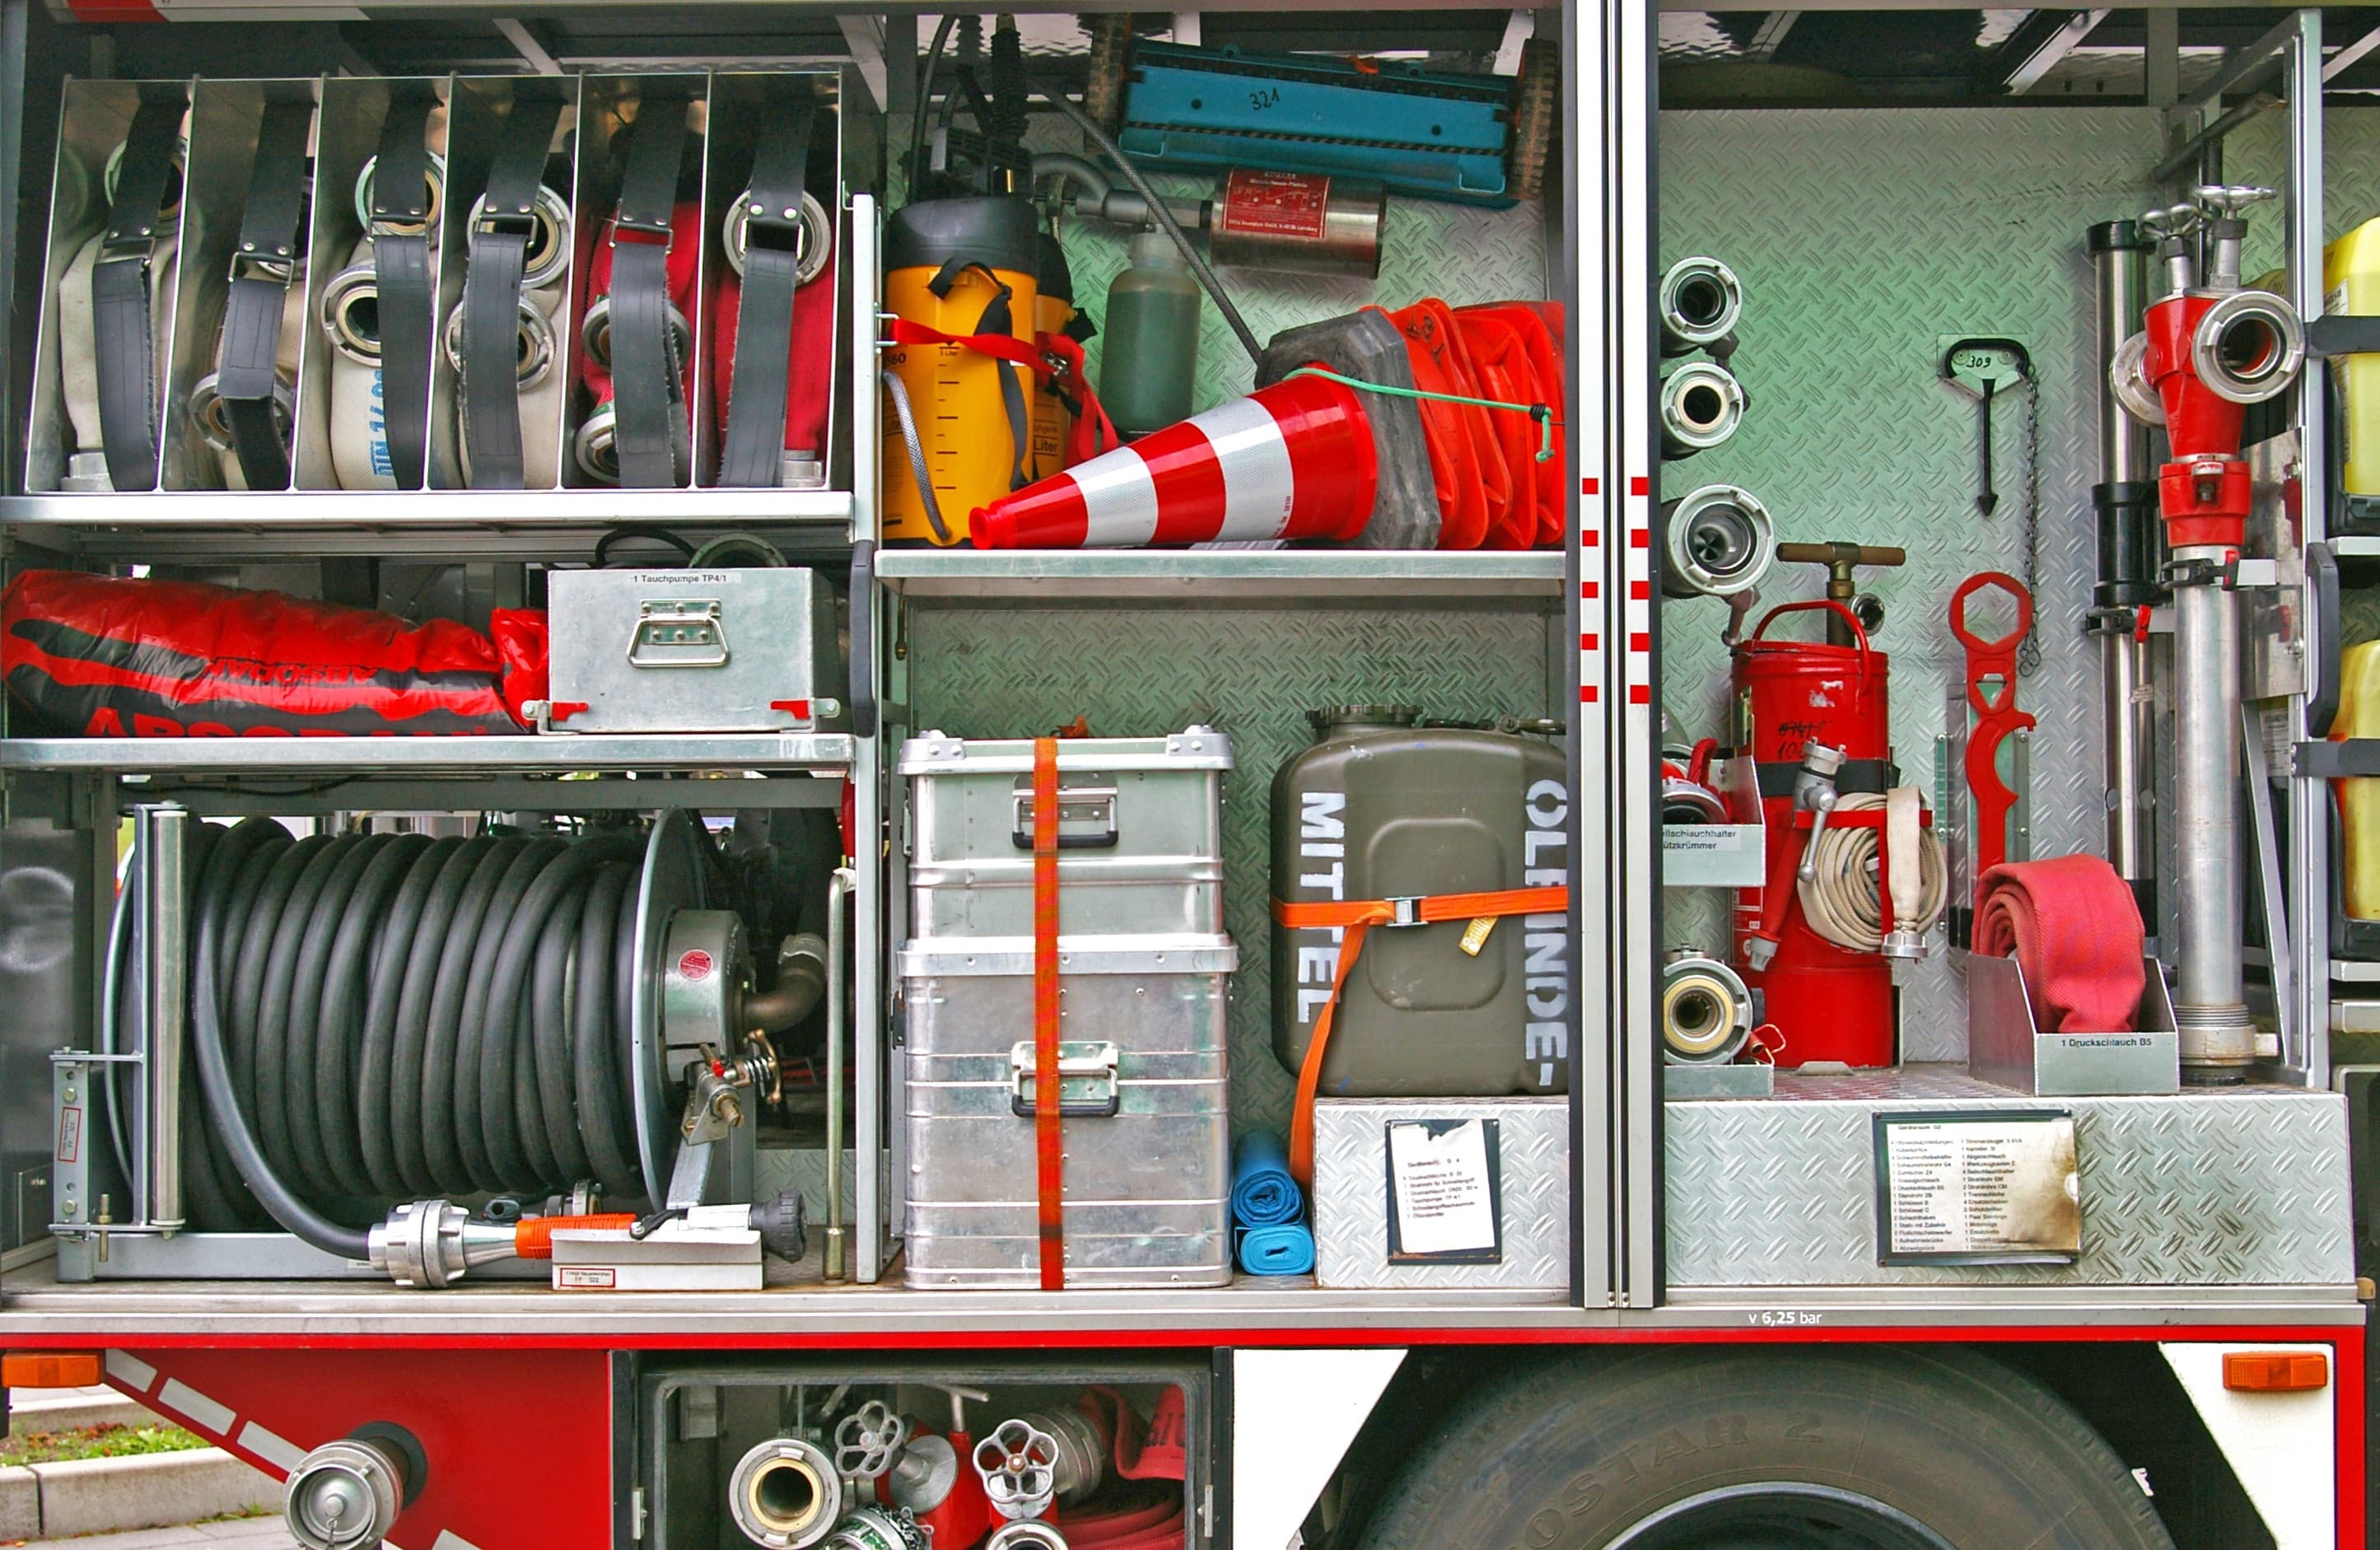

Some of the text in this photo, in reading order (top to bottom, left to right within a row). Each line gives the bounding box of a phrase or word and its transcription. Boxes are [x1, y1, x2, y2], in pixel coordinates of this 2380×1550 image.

[1966, 356, 1991, 368] 309
[642, 575, 699, 584] Tauchpumpe
[2069, 1039, 2136, 1048] Druckschlauch
[2140, 1038, 2152, 1046] B5
[1748, 1311, 1822, 1327] v 6,25 bar
